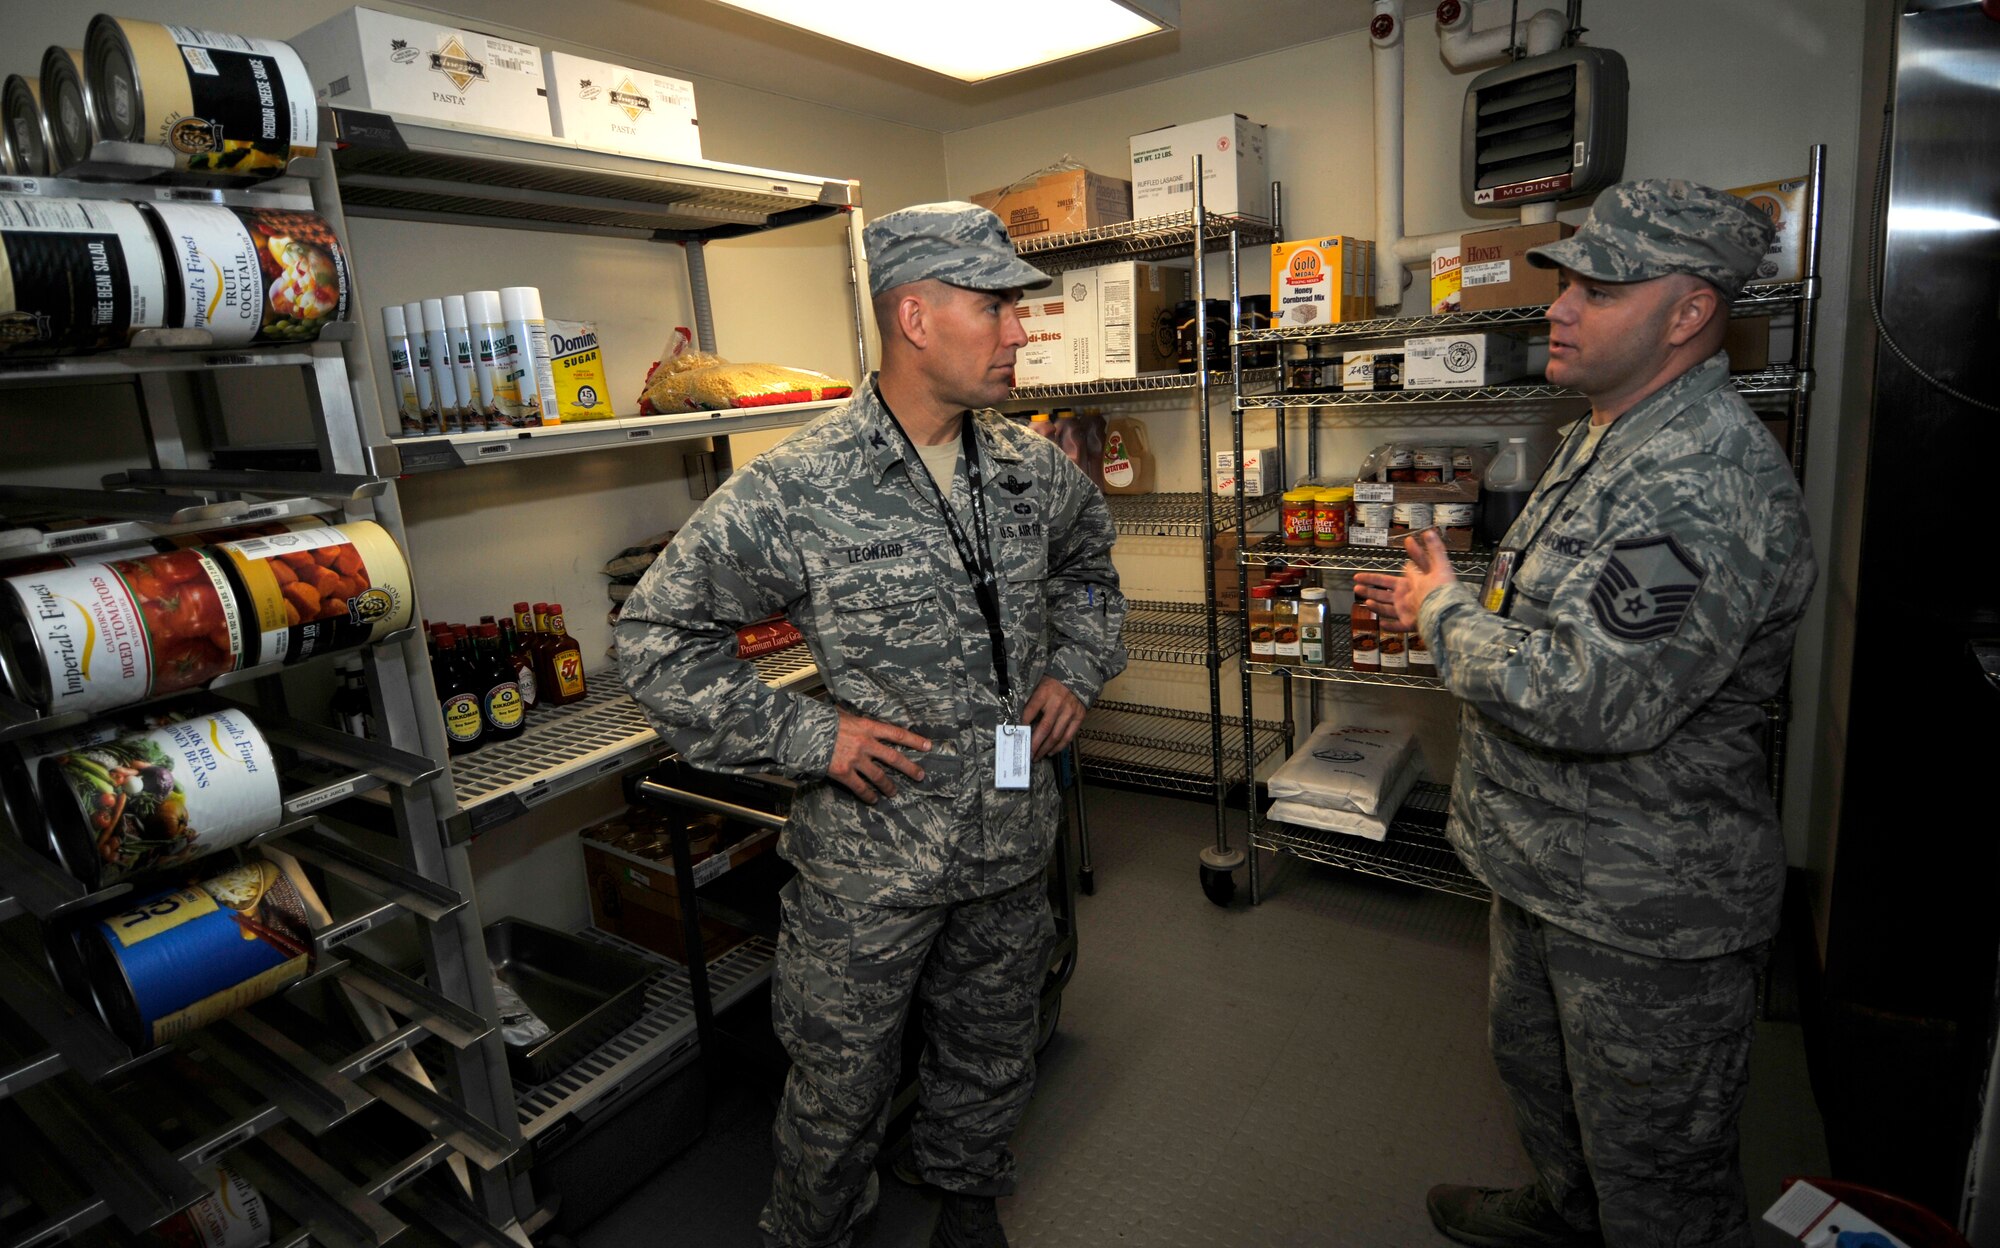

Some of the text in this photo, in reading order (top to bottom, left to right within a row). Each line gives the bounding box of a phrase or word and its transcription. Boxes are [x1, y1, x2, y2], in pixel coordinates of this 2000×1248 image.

[249, 58, 276, 140] CHEDDAR CHEESE SAUCE
[432, 91, 464, 106] PASTA
[159, 111, 181, 146] NARCH
[611, 123, 637, 136] PASTA
[1137, 175, 1183, 188] RUFFLED LASAGNE
[1503, 181, 1560, 196] MODINE
[1011, 207, 1028, 216] ARGO
[1294, 256, 1316, 271] Gold
[1438, 255, 1460, 270] Dom
[1467, 246, 1502, 262] HONEY
[96, 275, 113, 298] BEAN
[181, 236, 207, 328] mperial's Finest
[223, 267, 237, 307] FRUIT
[236, 251, 252, 319] COCKTAIL
[1295, 287, 1312, 295] Honey
[1283, 295, 1313, 304] Cornbread
[97, 300, 113, 325] THREE
[550, 332, 597, 355] Domino
[1028, 332, 1061, 343] di-Bits
[564, 352, 596, 368] SUGAR
[582, 390, 592, 398] 15
[1104, 461, 1129, 474] CITATION
[1000, 525, 1017, 539] U.S.
[1018, 524, 1031, 537] AIR
[1291, 516, 1313, 528] Peter
[847, 543, 904, 564] LEONARD
[90, 576, 135, 679] DICED TOMATOES
[92, 602, 115, 653] CALIFORNIA
[303, 624, 316, 638] CUT
[29, 584, 86, 697] Imperial's Finest
[740, 632, 803, 654] Premium Long Gra
[561, 657, 579, 678] 57
[181, 725, 217, 771] DARK RED
[235, 740, 259, 773] Finest
[184, 750, 210, 789] BEANS
[296, 788, 345, 809] PINEAPPLE JUICE
